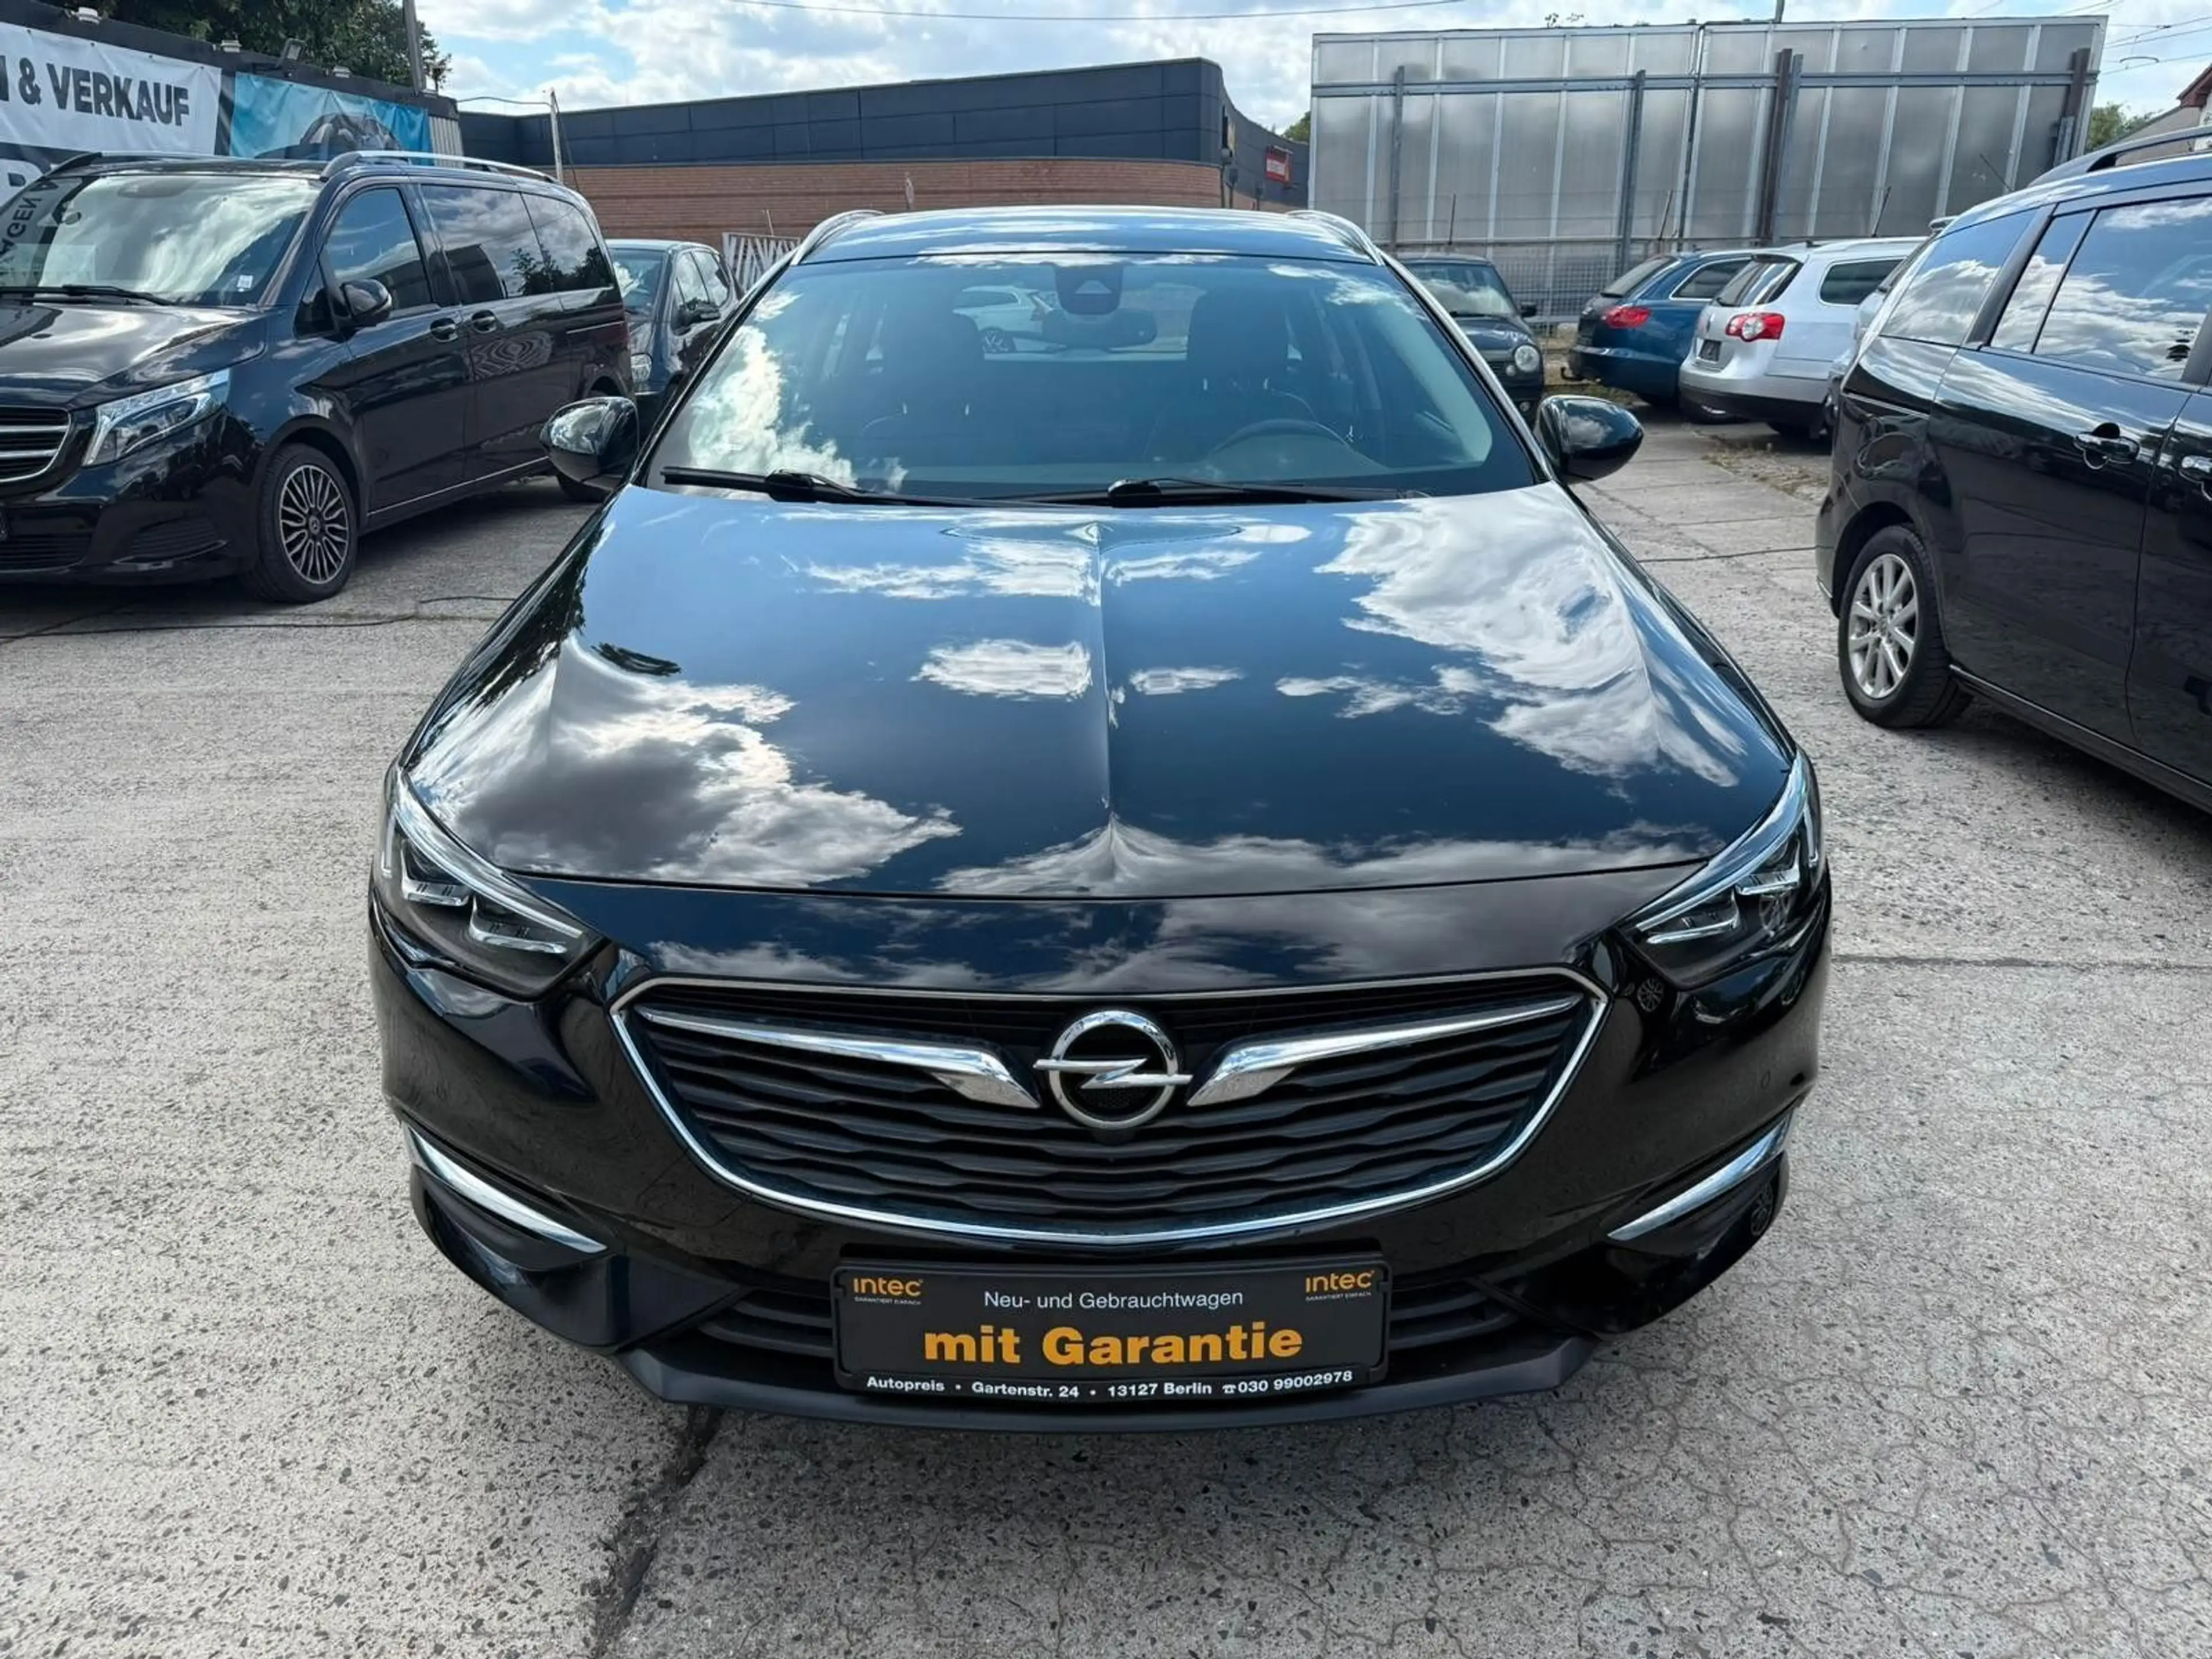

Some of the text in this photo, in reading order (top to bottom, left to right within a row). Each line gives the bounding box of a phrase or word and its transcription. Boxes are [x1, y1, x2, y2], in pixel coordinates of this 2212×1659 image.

[19, 58, 41, 105] &
[46, 63, 189, 126] VERKAUF
[984, 1291, 1243, 1309] Neu- und Gebrauchtwagen
[925, 1321, 1302, 1365] mit Garantie
[866, 1376, 945, 1392] Autopreis
[971, 1381, 1053, 1397] Gartenstr.
[1059, 1385, 1079, 1397] 24
[1108, 1384, 1158, 1397] 13127
[1164, 1382, 1213, 1395] Berlin
[1274, 1370, 1353, 1391] 99002978
